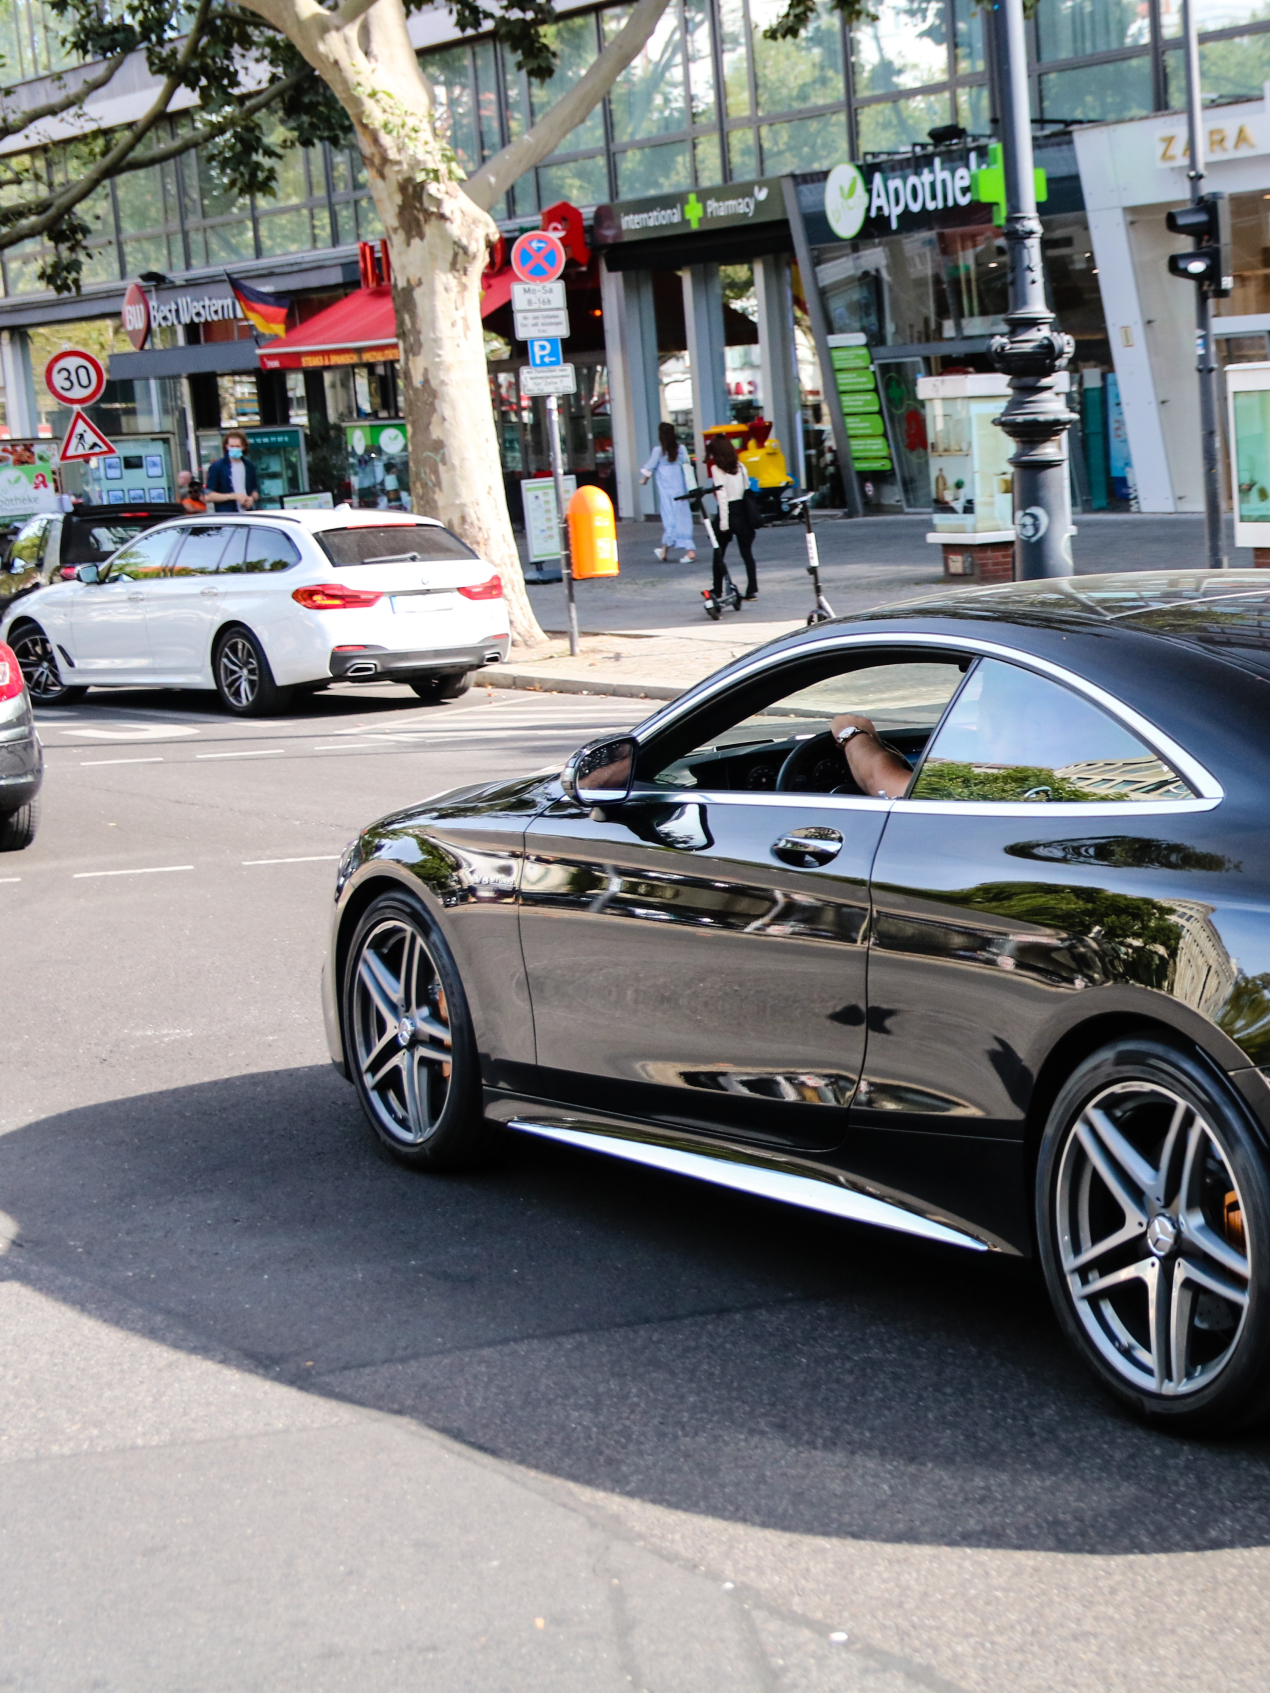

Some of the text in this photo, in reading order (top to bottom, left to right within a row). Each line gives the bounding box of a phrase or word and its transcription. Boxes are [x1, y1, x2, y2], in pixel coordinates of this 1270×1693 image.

[1159, 124, 1255, 162] ZRA
[706, 197, 756, 218] Pharmacy
[523, 286, 553, 295] Mo-Sa
[125, 304, 145, 331] BW
[150, 300, 178, 328] Best
[177, 295, 235, 325] Western
[533, 341, 551, 365] P
[57, 365, 91, 391] 30
